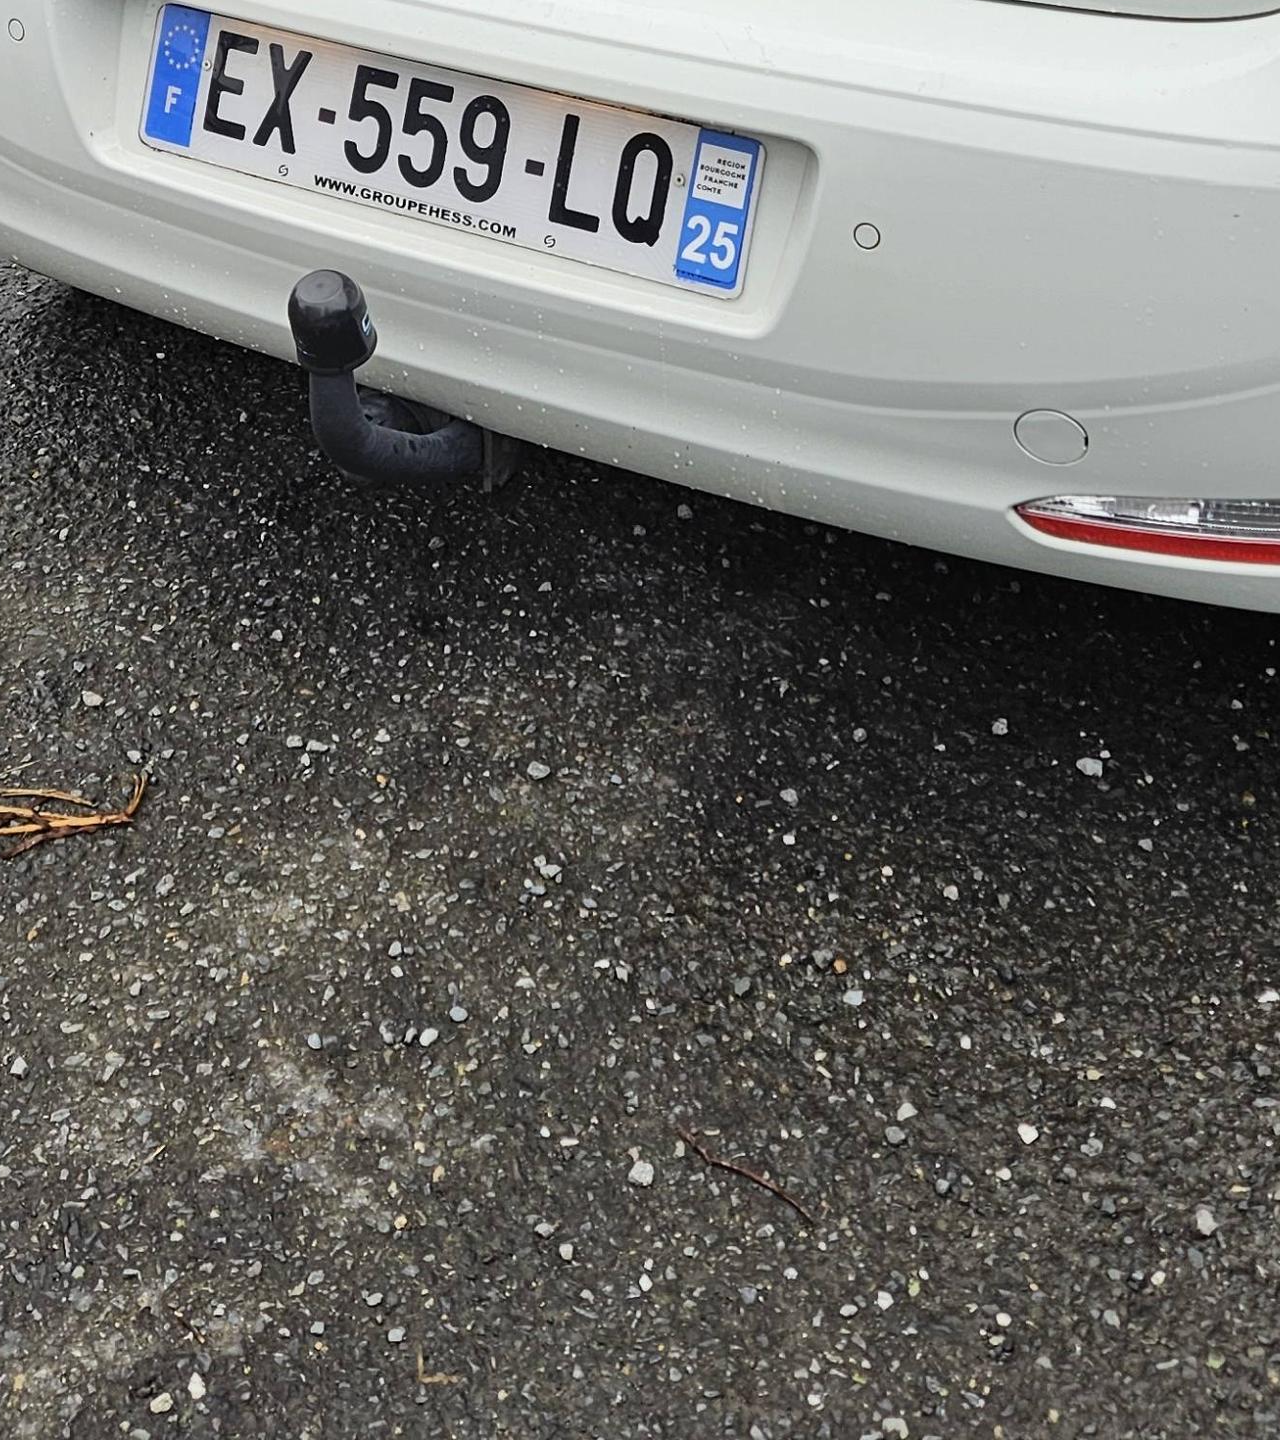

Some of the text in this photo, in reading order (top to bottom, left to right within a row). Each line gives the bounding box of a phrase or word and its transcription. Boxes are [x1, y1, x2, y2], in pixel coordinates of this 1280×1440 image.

[164, 85, 182, 114] F
[203, 30, 675, 247] EX-559-LQ
[314, 175, 517, 239] WWW.GROUPEHESS.COM
[681, 214, 739, 270] 25
